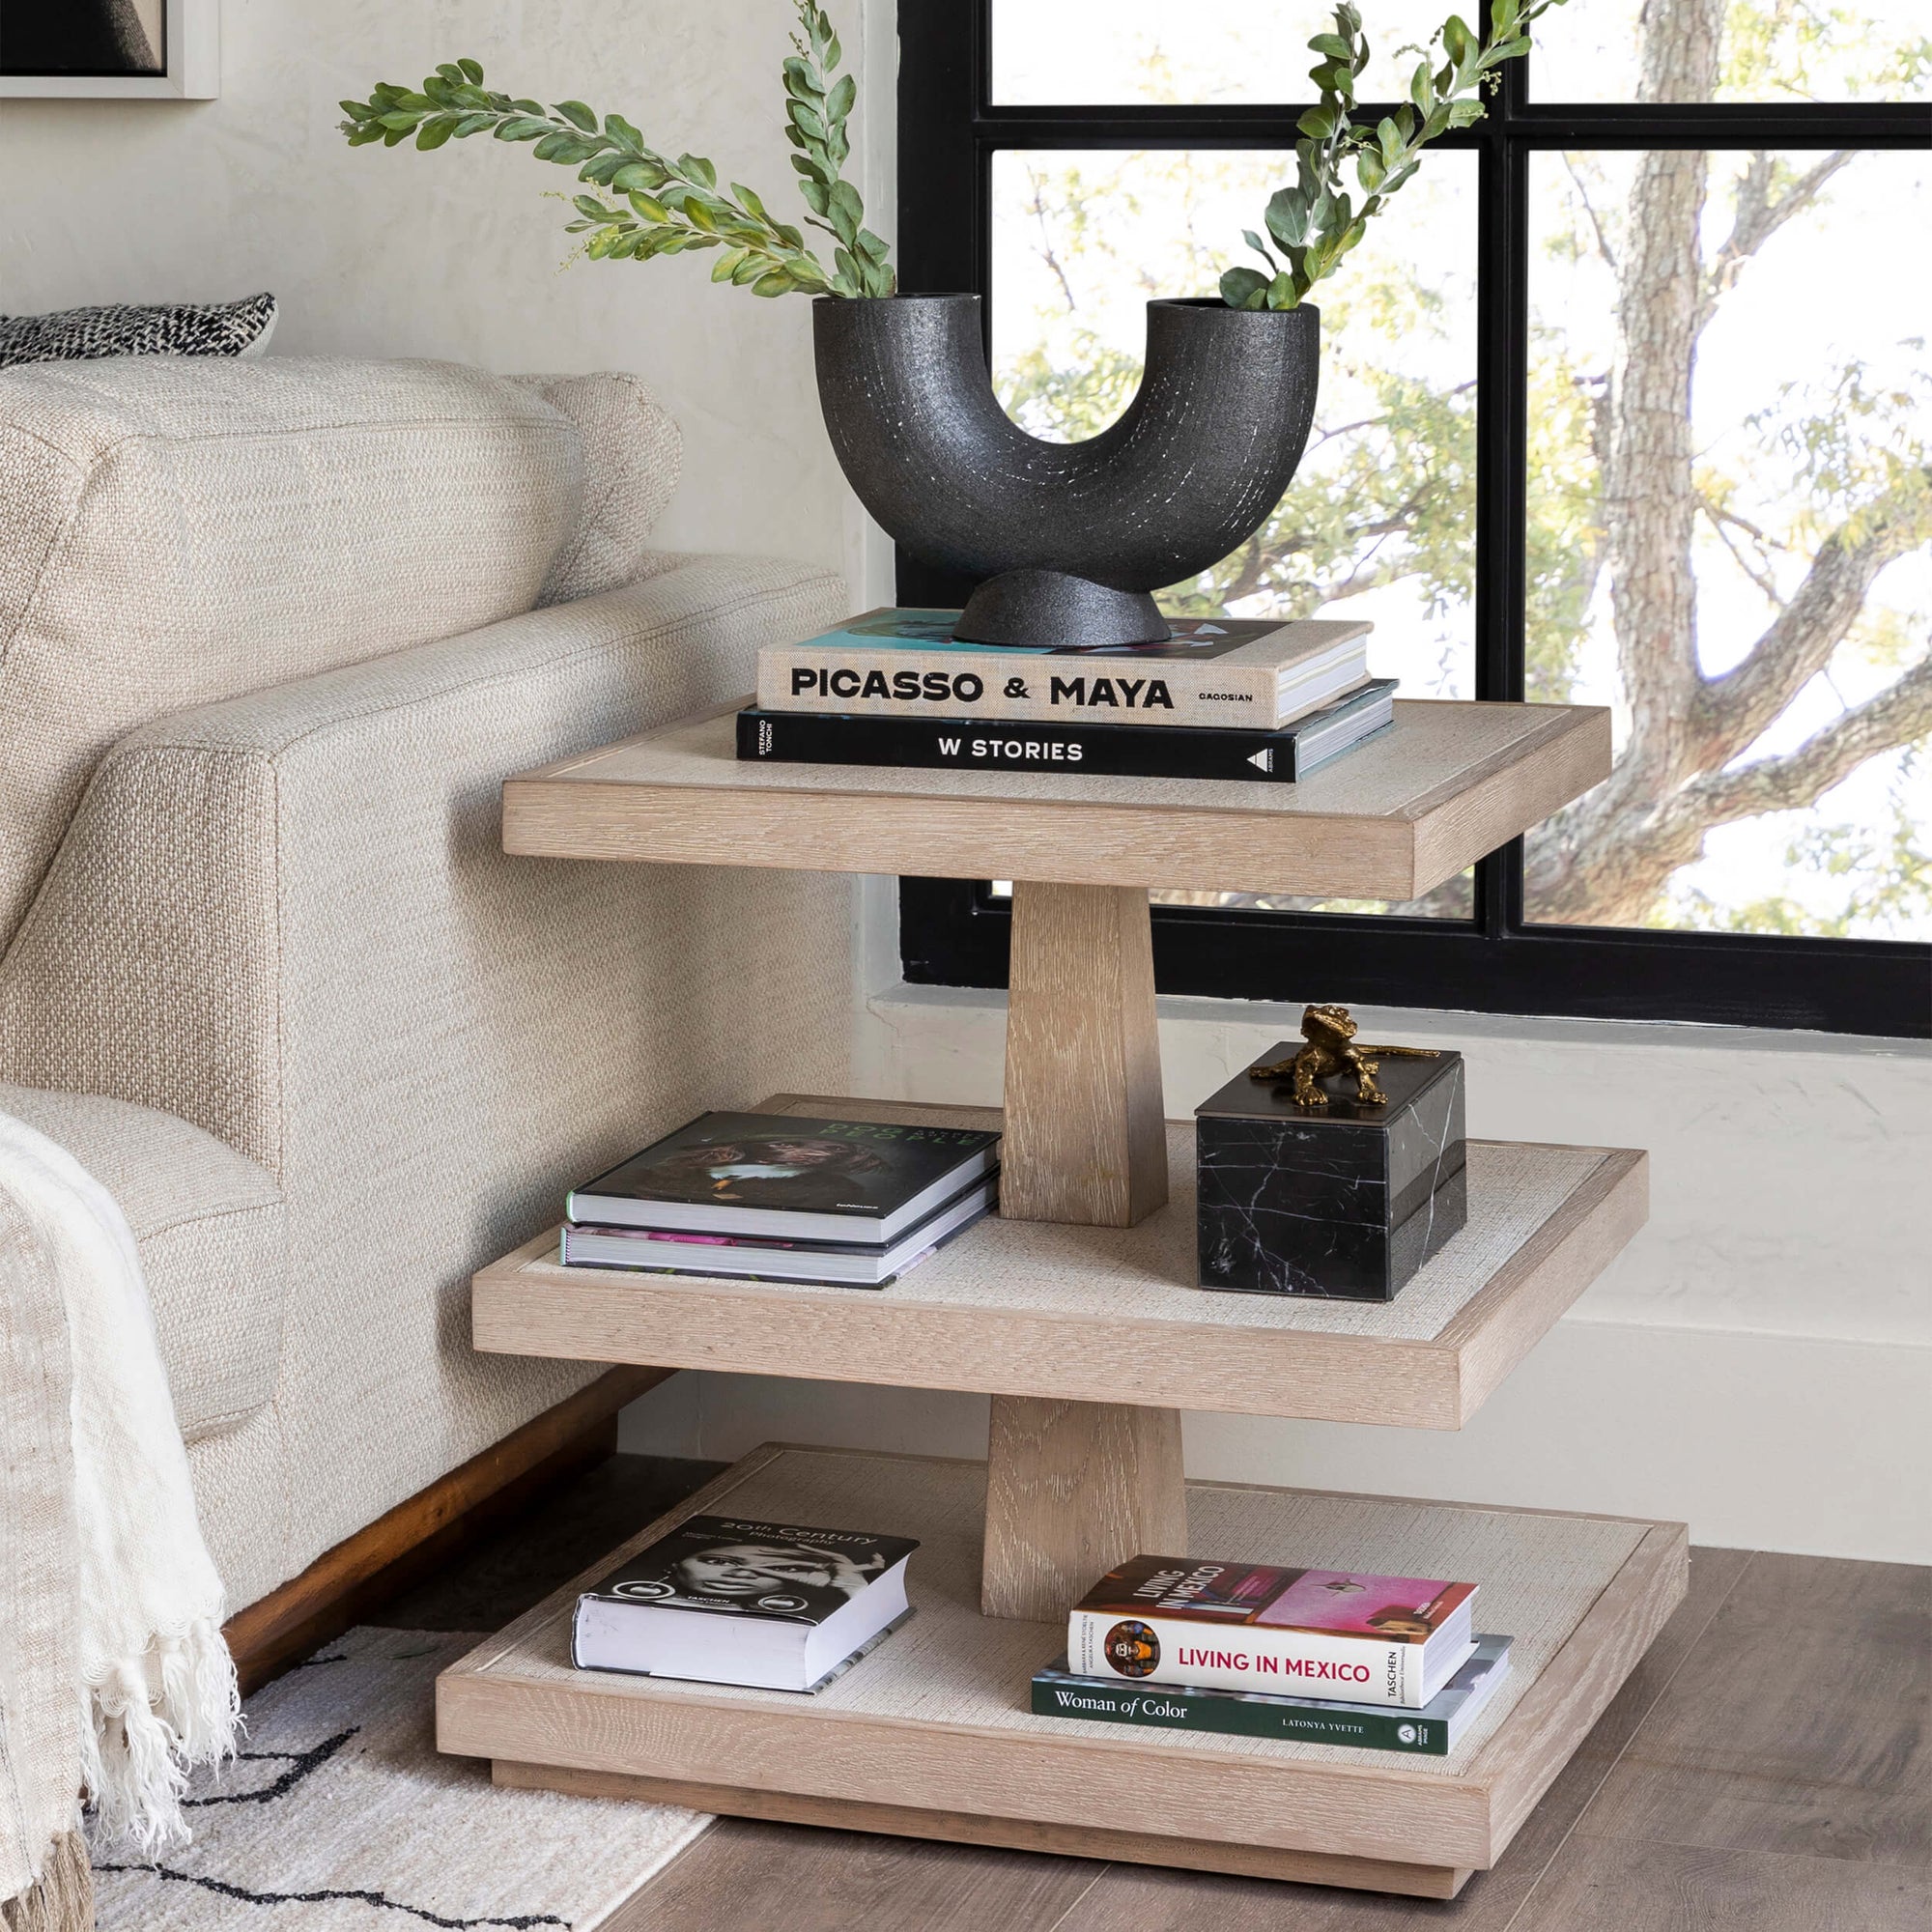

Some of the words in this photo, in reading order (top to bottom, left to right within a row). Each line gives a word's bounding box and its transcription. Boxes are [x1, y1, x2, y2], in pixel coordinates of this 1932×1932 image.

[791, 668, 984, 702] PICASSO
[1004, 677, 1031, 698] &
[1050, 676, 1175, 709] MAYA
[1199, 692, 1253, 702] GAGOSIAN
[938, 737, 961, 755] W
[971, 739, 1083, 761] STORIES
[820, 1128, 976, 1146] PEOPLE
[827, 1123, 904, 1134] DOG
[721, 1522, 772, 1531] 20th
[779, 1527, 878, 1546] Century
[749, 1531, 836, 1546] Photography
[1133, 1570, 1185, 1599] LIVING
[1168, 1566, 1226, 1599] MEXICO
[1155, 1598, 1190, 1610] IN
[1179, 1648, 1249, 1670] LIVING
[1256, 1655, 1278, 1674] IN
[1285, 1659, 1370, 1683] MEXICO
[1387, 1651, 1397, 1697] TASCHEN
[1055, 1690, 1116, 1712] Woman
[1121, 1697, 1140, 1718] of
[1142, 1700, 1187, 1719] Color
[1282, 1719, 1325, 1730] LATONYA
[1328, 1722, 1364, 1734] YVETTE
